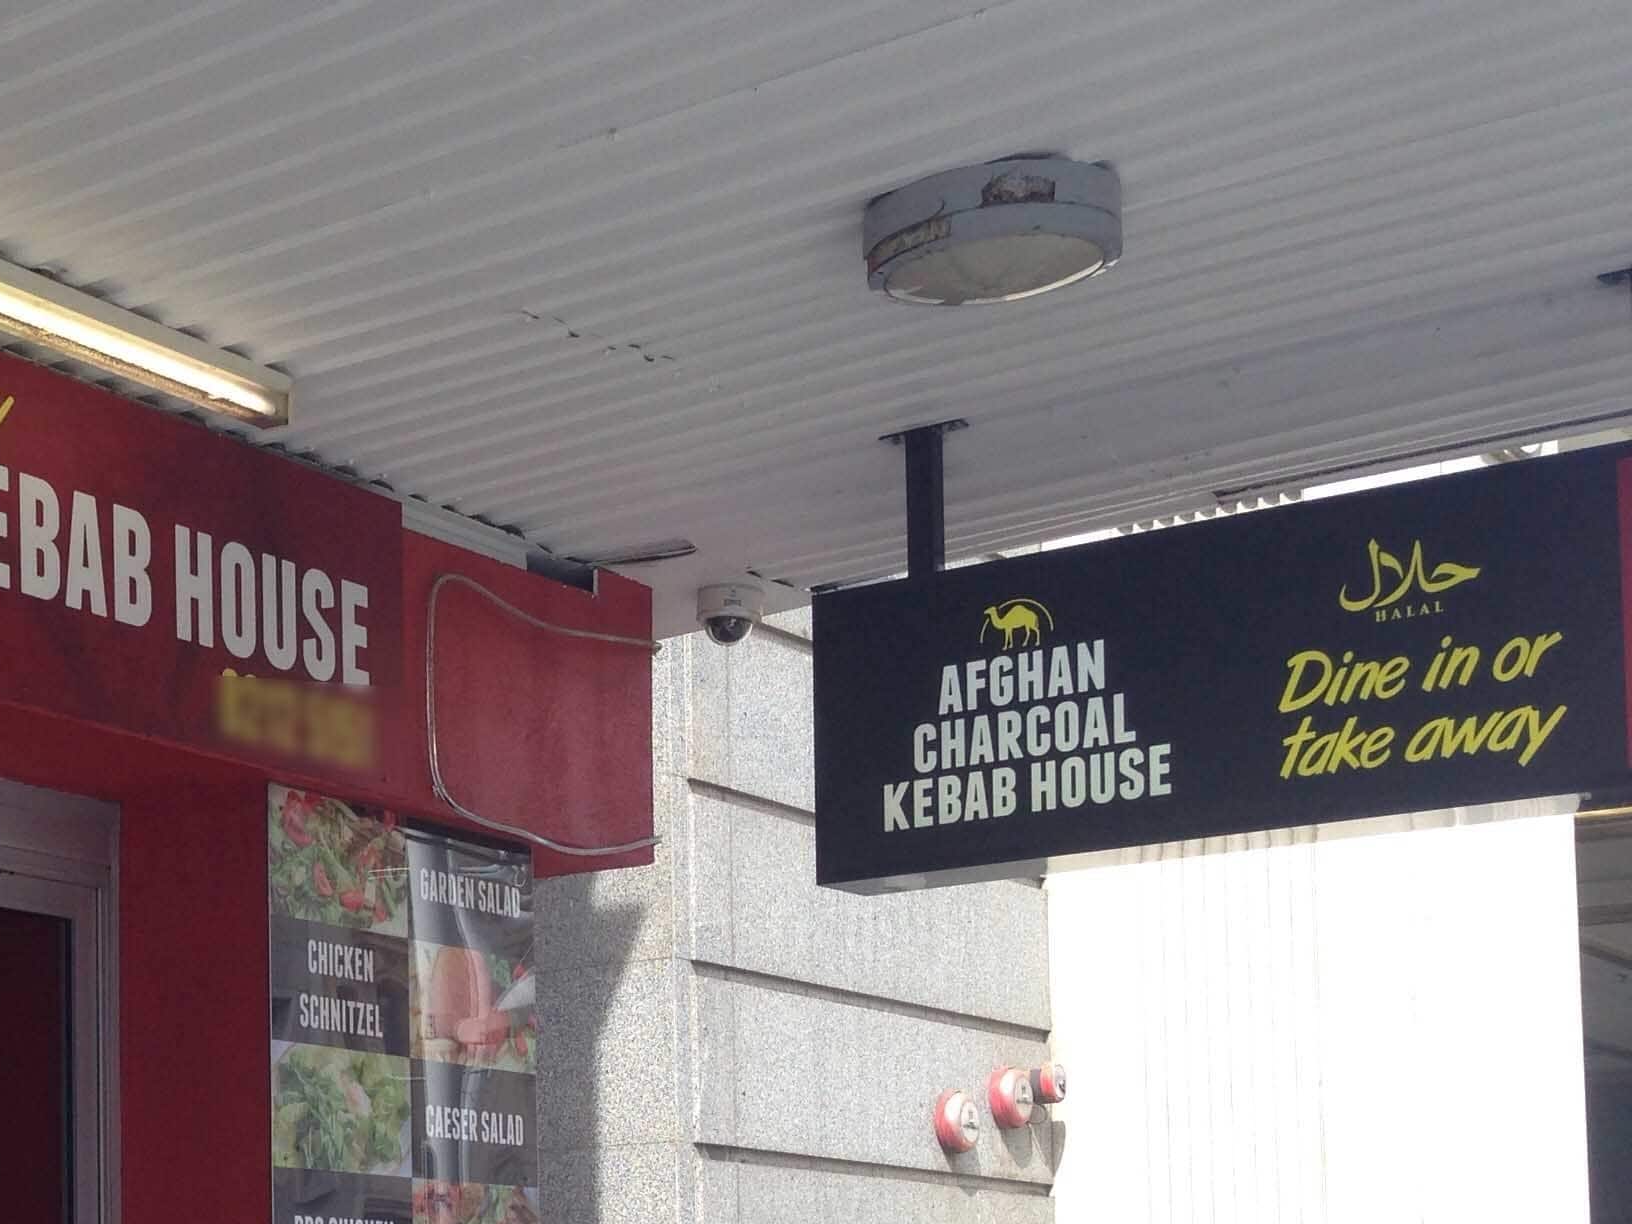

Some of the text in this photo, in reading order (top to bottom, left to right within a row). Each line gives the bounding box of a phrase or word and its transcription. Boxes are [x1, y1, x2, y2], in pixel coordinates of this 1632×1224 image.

[175, 524, 370, 686] HOUSE
[1375, 601, 1444, 623] HALAL
[938, 639, 1106, 716] AFGHAN
[1278, 631, 1563, 715] Dine in or
[913, 692, 1136, 774] CHARCOAL
[1280, 704, 1568, 780] take away
[883, 744, 1172, 832] KEBAB HOUSE
[419, 867, 521, 918] GARDEN SALAD
[308, 939, 374, 983] CHICKEN
[299, 993, 383, 1038] SCHNITZEL
[425, 1104, 524, 1147] CAESER SALAD
